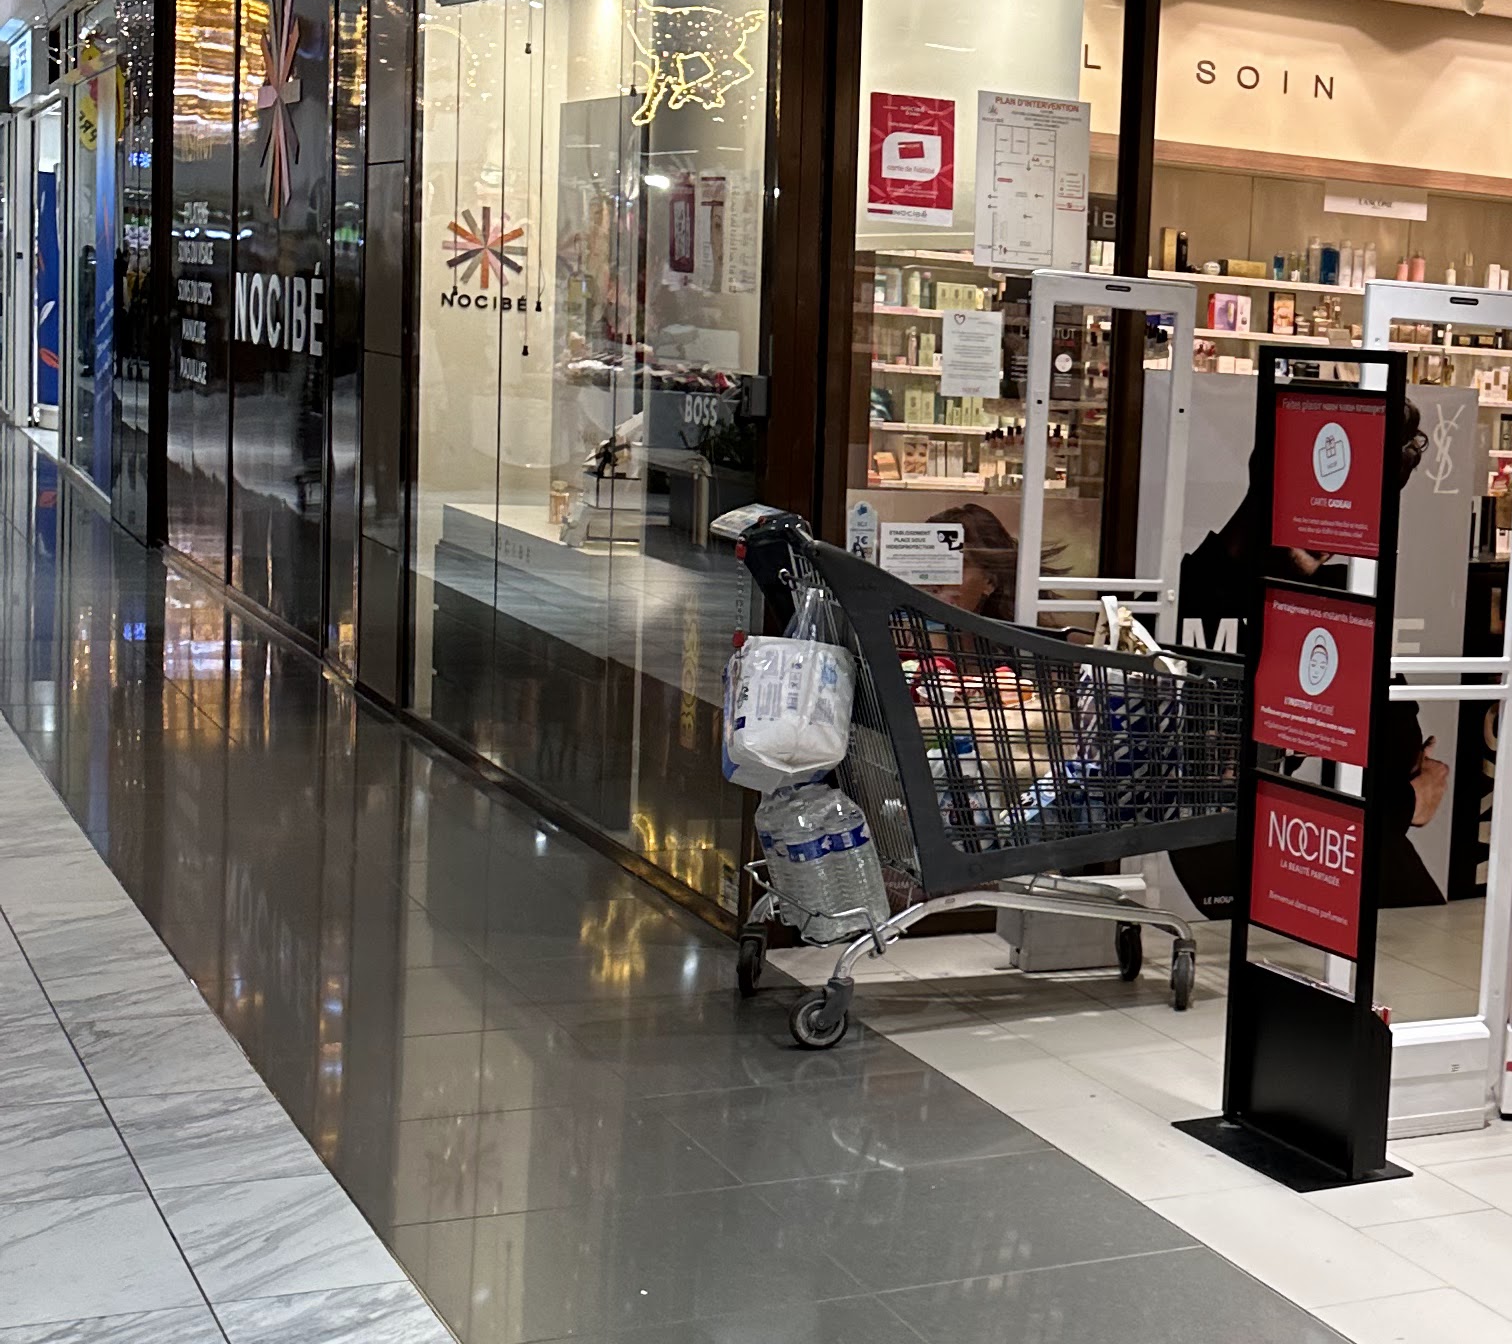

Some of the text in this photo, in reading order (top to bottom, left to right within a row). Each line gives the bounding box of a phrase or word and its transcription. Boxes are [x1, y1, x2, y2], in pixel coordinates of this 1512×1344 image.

[1195, 59, 1334, 100] SOIN
[995, 96, 1080, 113] PLAN D'INTERVENTION
[234, 261, 324, 357] NOCIBÉ
[440, 292, 528, 312] NOCIBÉ
[684, 394, 718, 427] BOSS
[1310, 496, 1352, 510] CARTE CADEAU
[1268, 810, 1357, 875] NOCIBÉ
[1280, 858, 1288, 869] LA
[1288, 861, 1310, 877] BEAUTÉ
[1203, 896, 1212, 905] LE
